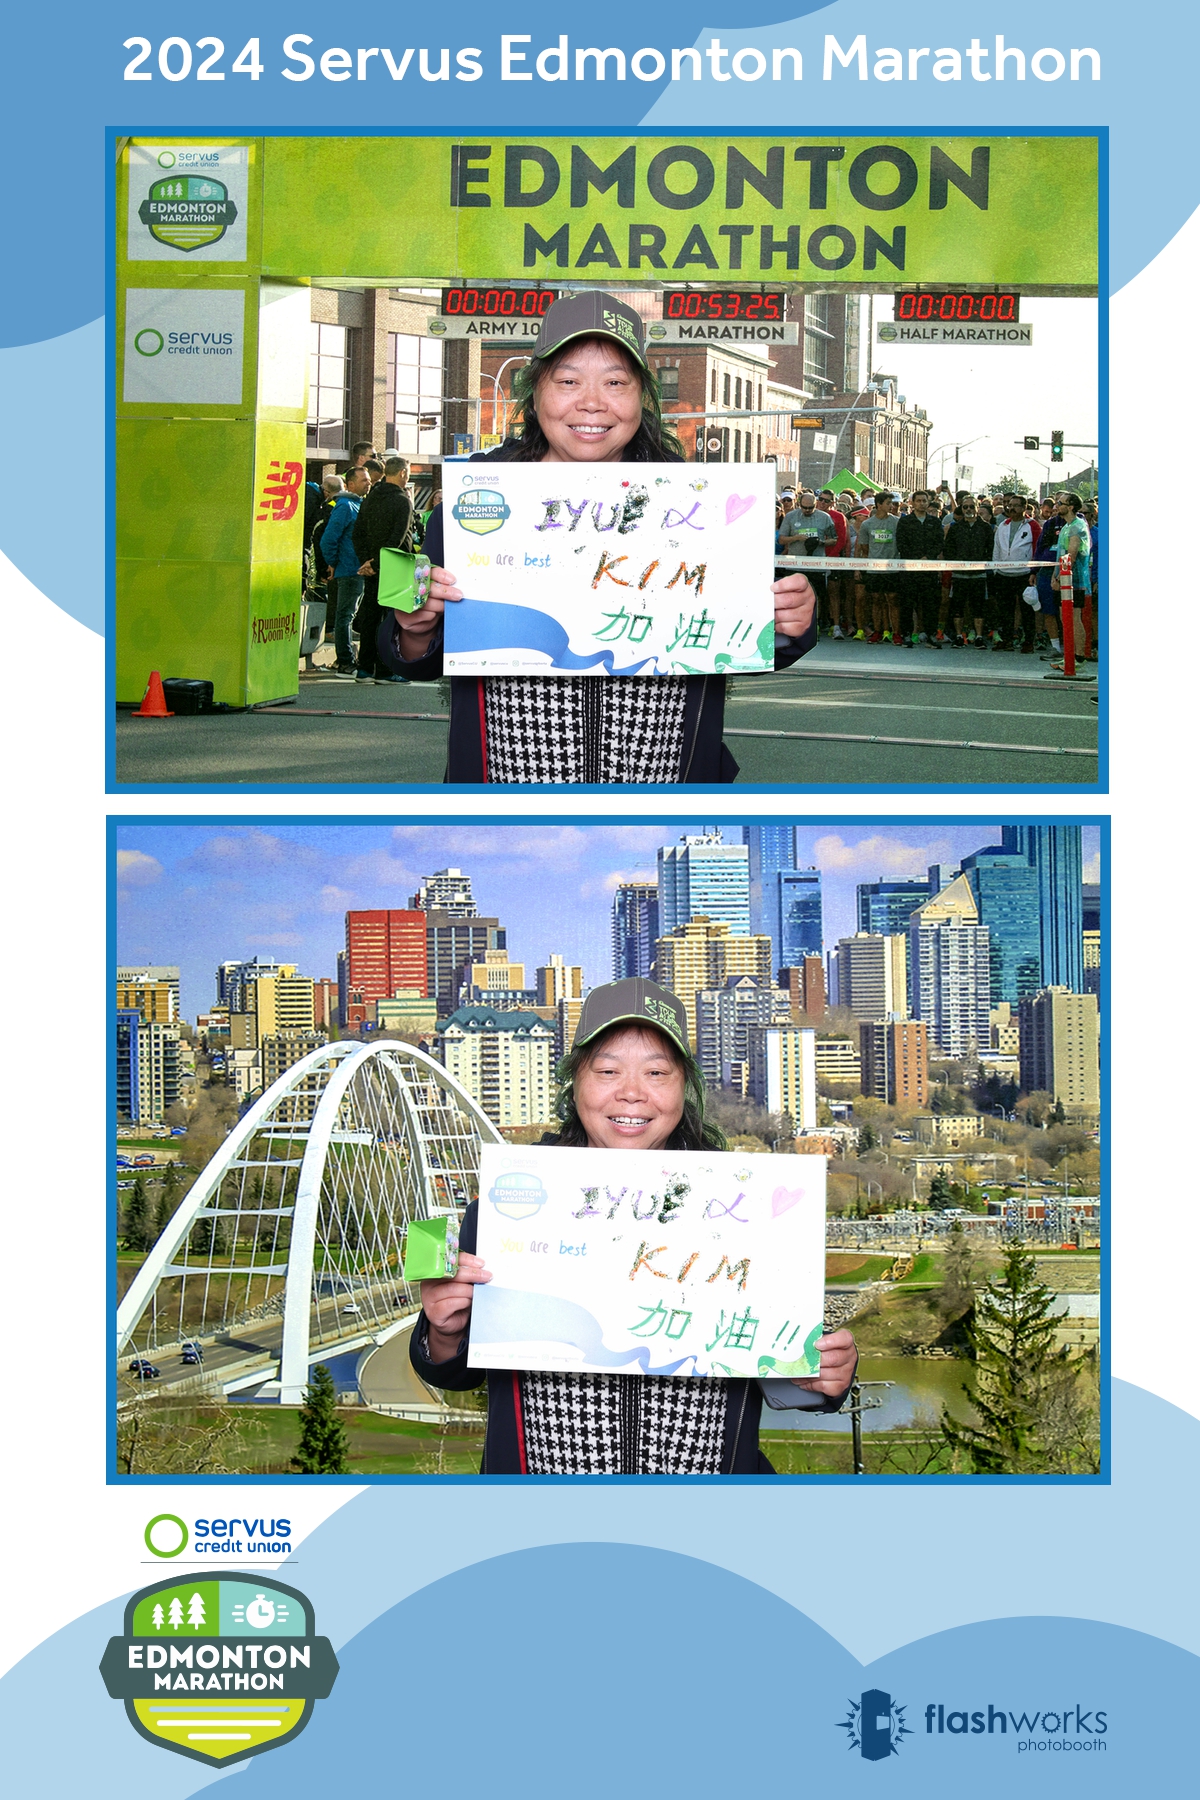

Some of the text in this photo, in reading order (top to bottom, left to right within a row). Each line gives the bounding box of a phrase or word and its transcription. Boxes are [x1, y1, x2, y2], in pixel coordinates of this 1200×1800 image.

[178, 152, 220, 161] servus
[450, 144, 991, 211] EDMONTON
[149, 202, 227, 214] EDMONTON
[160, 214, 215, 222] MARATHON
[523, 223, 906, 271] MARATHON
[466, 321, 518, 336] ARMY
[679, 325, 785, 340] MARATHON
[900, 328, 939, 340] HALF
[943, 329, 1031, 341] MARATHON
[168, 332, 233, 345] servus
[168, 345, 233, 355] credit union
[495, 553, 514, 566] are
[524, 552, 552, 568] best
[591, 550, 708, 598] KIM
[494, 1188, 542, 1198] EDMONTON
[529, 1240, 549, 1253] are
[559, 1239, 588, 1256] best
[629, 1240, 751, 1294] KIM
